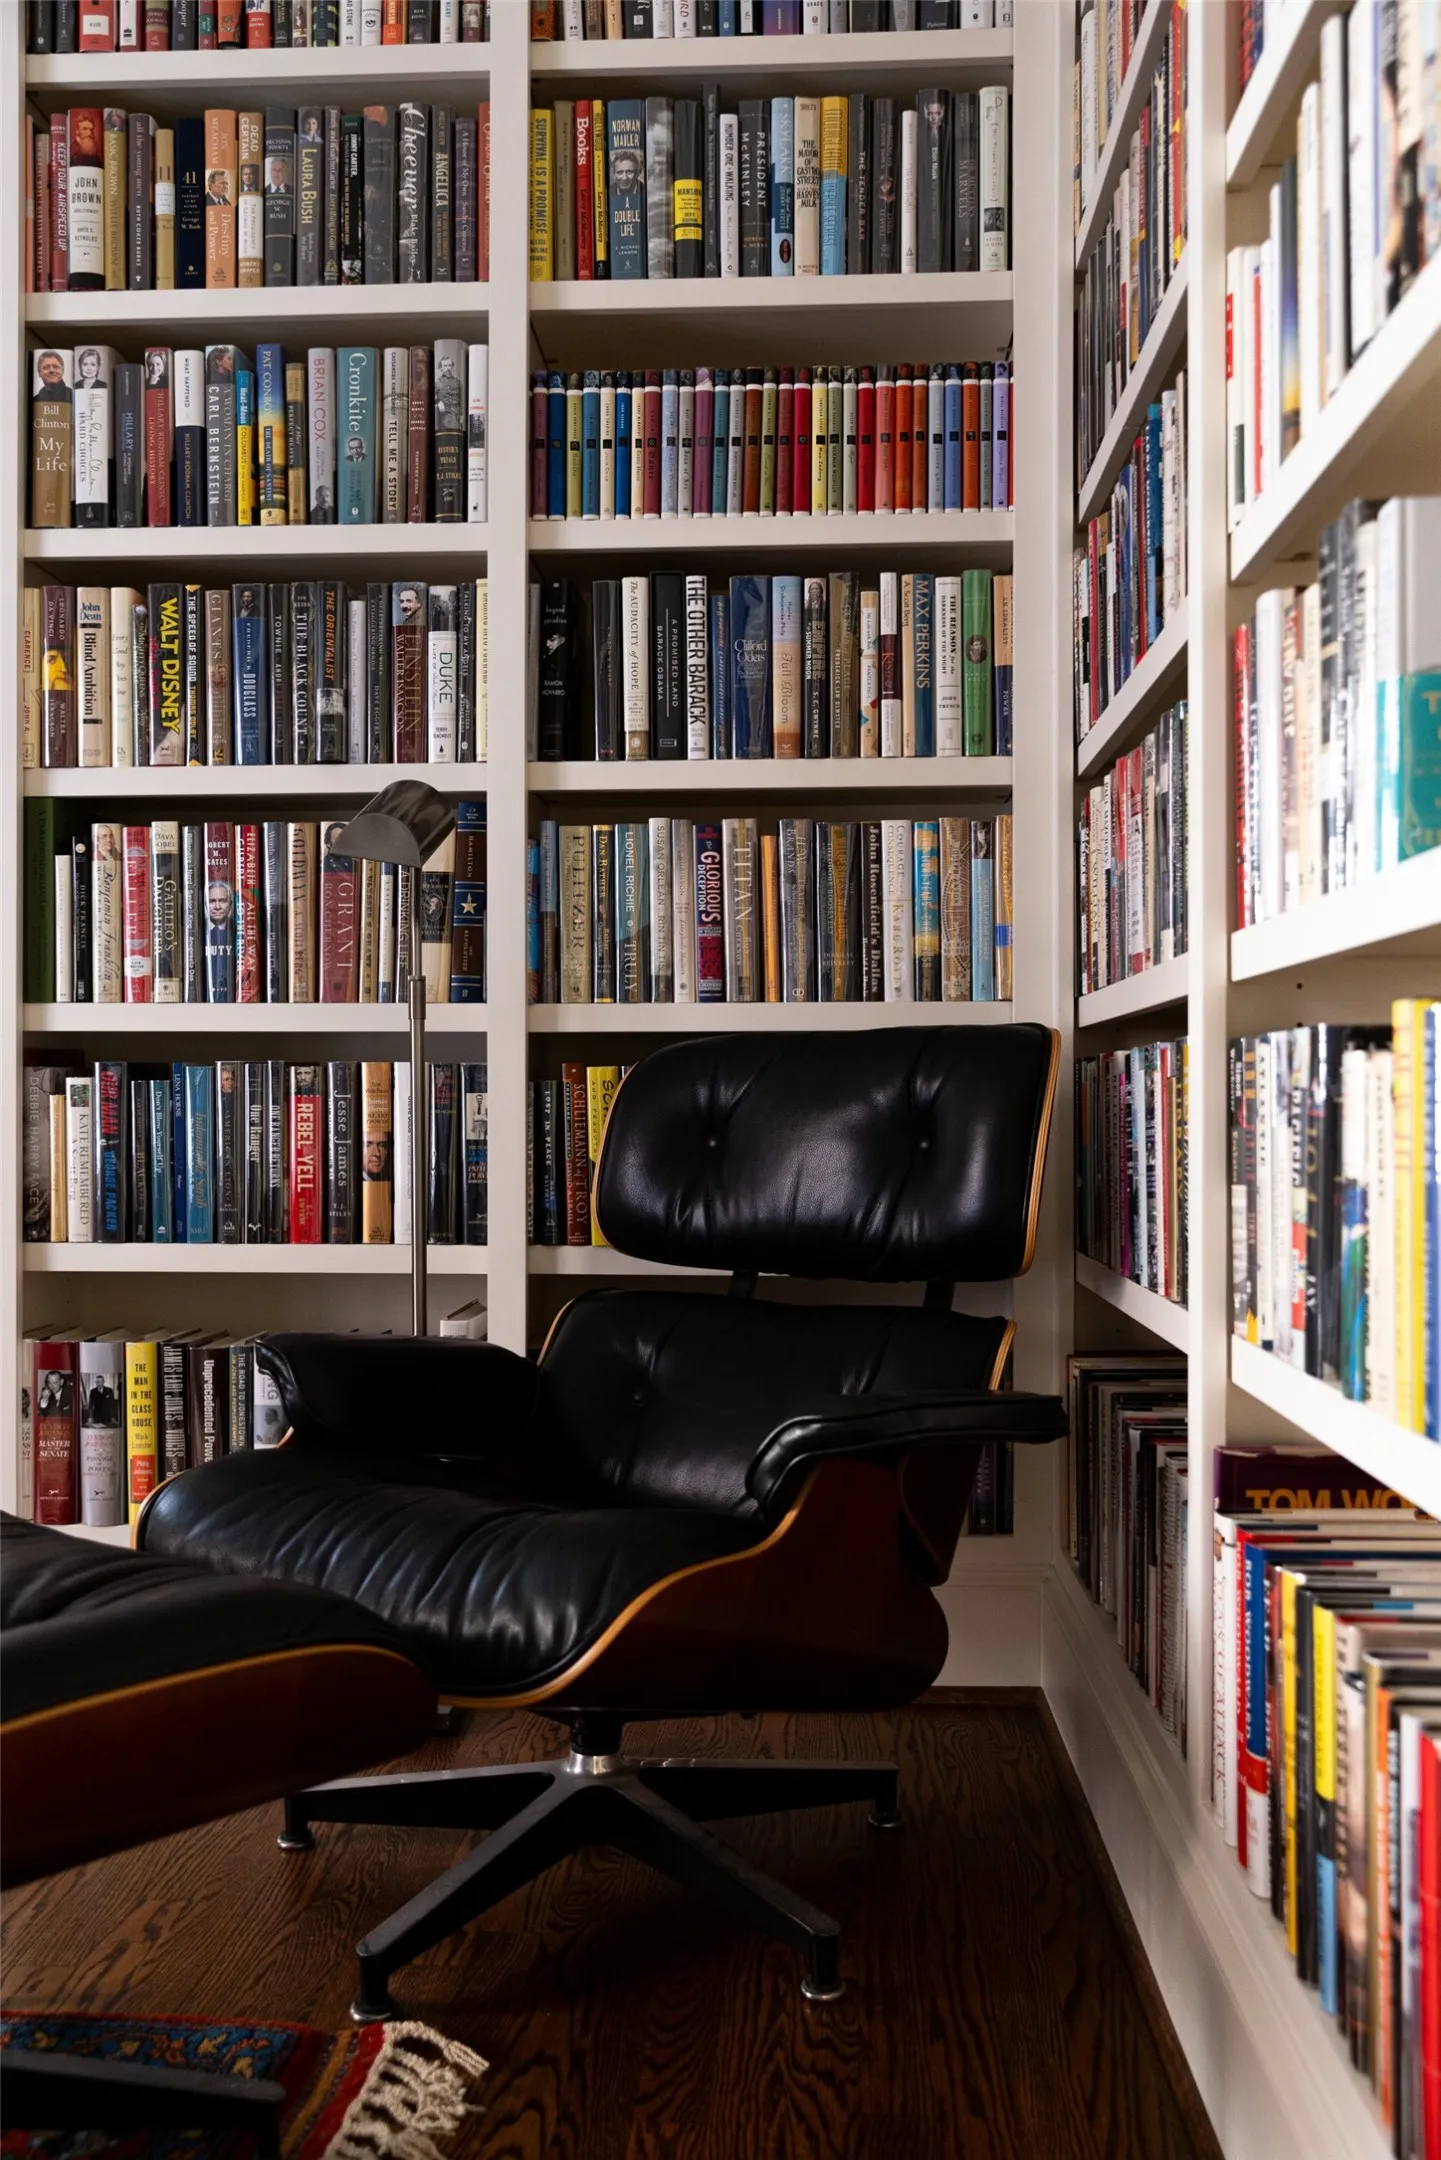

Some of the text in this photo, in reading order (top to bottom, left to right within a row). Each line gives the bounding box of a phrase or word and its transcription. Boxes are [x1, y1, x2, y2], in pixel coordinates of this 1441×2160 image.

[250, 125, 258, 152] DEAD
[577, 117, 588, 165] Books
[612, 121, 640, 132] NORMAN
[614, 136, 640, 146] MAILER
[75, 178, 98, 188] JOHN
[436, 153, 448, 206] ANGELICA
[536, 118, 546, 234] SURVIVAL IS A PROMISE
[726, 154, 734, 166] ONE
[742, 132, 750, 207] McKINLEY
[757, 132, 765, 207] PRESIDENT
[58, 143, 66, 251] KEEP YOUR AIRSPEED UP
[72, 193, 101, 204] BROWN
[301, 149, 317, 224] LAURA BUSH
[625, 197, 629, 208] A
[726, 171, 734, 201] WALKING
[218, 214, 230, 257] Destiny
[580, 209, 588, 249] McMurtry
[614, 211, 640, 222] DOUBLE
[621, 225, 639, 236] LIFE
[208, 227, 218, 260] Power
[263, 351, 271, 370] PAT
[44, 406, 59, 415] Bill
[313, 358, 325, 440] BRIAN COX
[348, 352, 367, 432] Cronkite
[34, 418, 69, 429] Clinton
[40, 438, 64, 455] My
[209, 386, 219, 504] CARL BERNSTEIN
[36, 458, 66, 471] Life
[389, 448, 396, 463] ME
[648, 450, 656, 480] Dante
[389, 478, 397, 508] STORY
[630, 581, 638, 594] The
[212, 595, 222, 659] GIANTS
[325, 591, 335, 680] THE ORIENTALIST
[630, 596, 638, 647] AUDACITY
[916, 580, 929, 688] MAX PERKINS
[84, 633, 96, 715] Blind Ambition
[160, 597, 180, 733] WALT DISNEY
[296, 613, 307, 735] THE BLACK COUNT
[629, 650, 638, 658] of
[688, 578, 706, 725] THE OTHER BARACK
[244, 673, 256, 717] DOUGLASS
[396, 634, 404, 733] WALTER ISAACSON
[404, 634, 421, 732] EINSTEIN
[439, 652, 452, 703] DUKE
[780, 652, 792, 724] Full Bloom
[573, 836, 584, 948] PULITZER
[599, 836, 607, 898] DAN RATHER
[625, 832, 634, 913] LIONEL RICHIE
[657, 863, 665, 906] ORLEAN
[698, 864, 706, 911] DECEPTION
[700, 851, 721, 922] GLORIOUS
[733, 842, 752, 920] TITAN
[164, 880, 178, 951] GALILEO'S
[337, 882, 353, 971] GRANT
[869, 826, 880, 992] John Rosenfield's Dallas
[893, 904, 904, 941] KARL
[624, 940, 637, 992] TRULY
[29, 1077, 38, 1168] DEBBIE HARRY
[251, 1105, 262, 1163] One Ranger
[334, 1090, 352, 1187] Jesse James
[80, 1114, 89, 1225] KATE REMEMBERED
[156, 1162, 163, 1173] Up
[297, 1104, 313, 1193] REBEL YELL
[574, 1084, 588, 1224] SCHLIEMANN TROY
[134, 1377, 148, 1385] MAN
[135, 1363, 147, 1372] THE
[163, 1346, 184, 1421] JAMES EARL JONES
[130, 1391, 152, 1399] IN THE
[131, 1404, 152, 1414] GLASS
[202, 1359, 214, 1462] Unprecedented Powe
[239, 1391, 245, 1400] TO
[131, 1418, 152, 1427] HOUSE
[165, 1429, 185, 1457] VOICES
[238, 1403, 246, 1447] JONESTOWN
[1216, 1695, 1224, 1783] ATTACK
